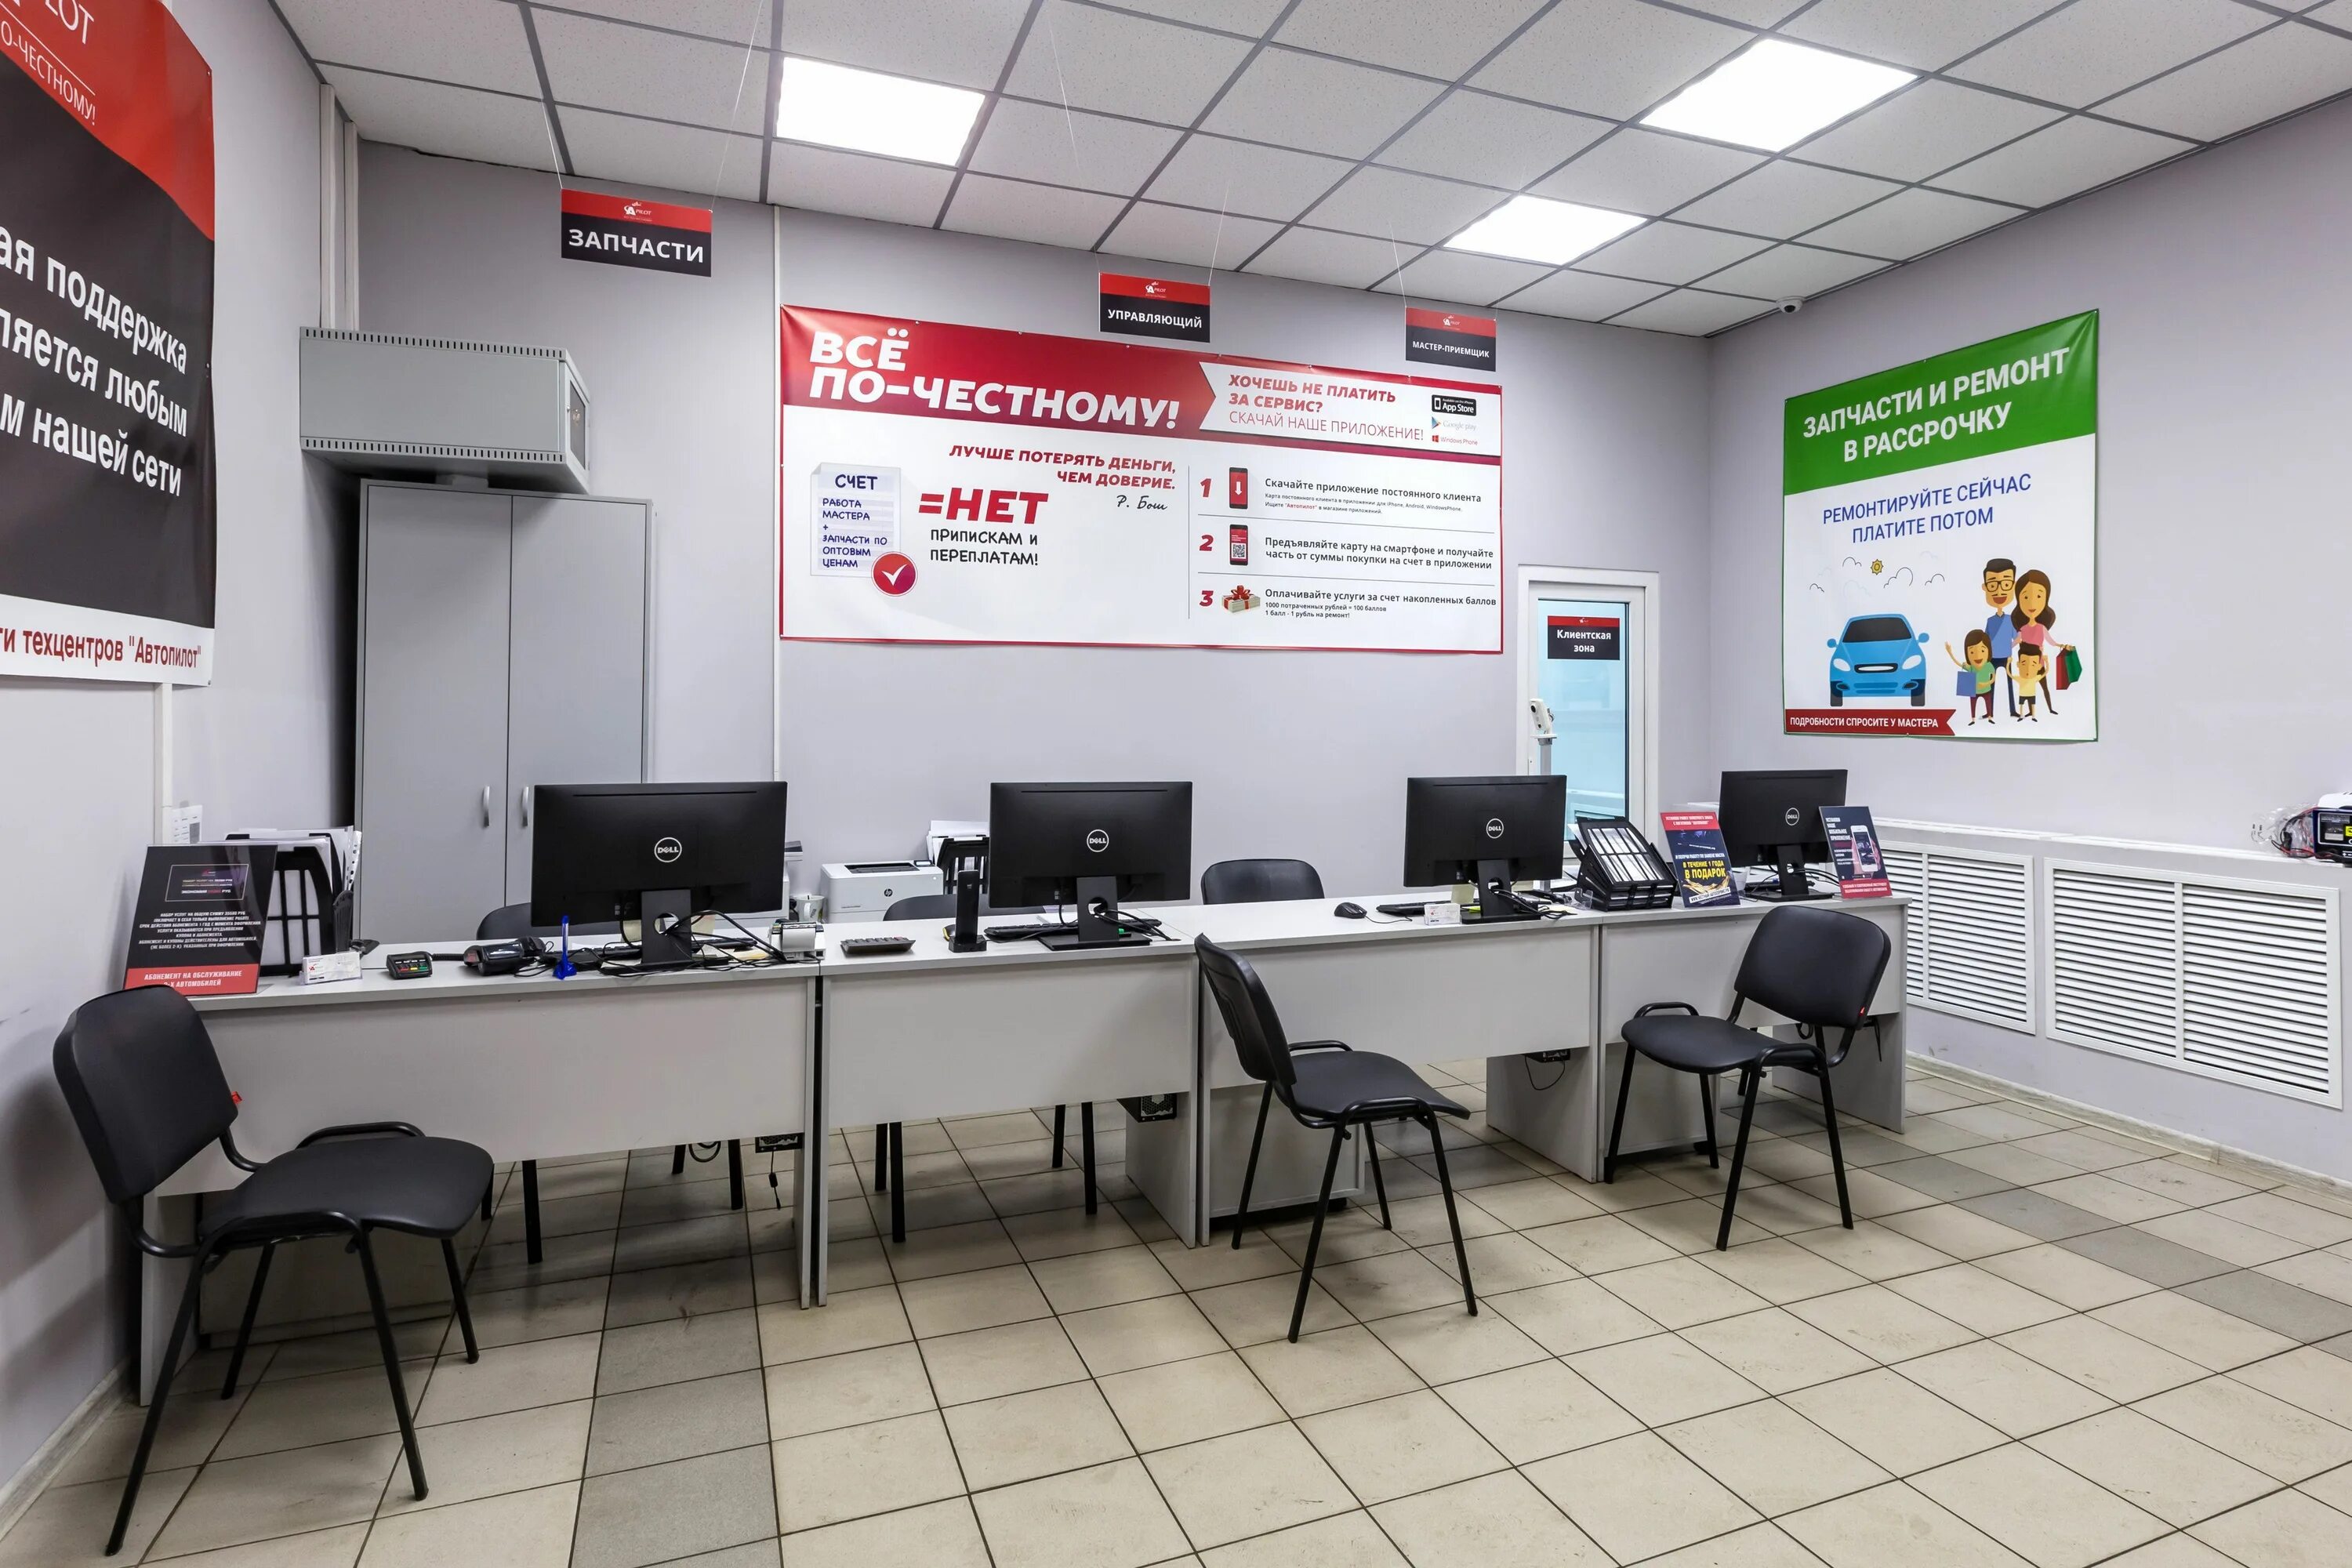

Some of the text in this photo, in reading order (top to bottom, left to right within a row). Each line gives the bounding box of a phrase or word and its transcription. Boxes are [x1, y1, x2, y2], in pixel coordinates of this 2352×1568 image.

[568, 229, 703, 263] ЗАПЧАСТИ
[47, 256, 187, 375] поддержка
[1108, 309, 1202, 328] УПРАВЛЯЮЩИЙ
[809, 327, 909, 372] ВСЁ
[1413, 341, 1490, 358] МАСТЕР-ПРИЕМЩИК
[1229, 375, 1396, 402] ХОЧЕШЬ НЕ ПЛАТИТЬ
[1803, 347, 2070, 438] ЗАПЧАСТИ И РЕМОНТ
[105, 368, 187, 437] любым
[809, 367, 1180, 429] ПО-ЧЕСТНОМУ!
[1229, 393, 1323, 412] ЗА СЕРВИС?
[1443, 402, 1474, 413] App Store
[1229, 412, 1424, 441] СКАЧАЙ НАШЕ ПРИЛОЖЕНИЕ!
[1443, 420, 1464, 430] Google
[1844, 401, 2013, 463] В РАССРОЧКУ
[32, 408, 128, 475] нашей
[132, 450, 181, 496] сети
[949, 445, 1176, 474] ЛУЧШЕ ПОТЕРЯТЬ ДЕНЬГИ,
[835, 474, 878, 490] СЧЕТ
[1057, 471, 1175, 489] ЧЕМ ДОВЕРИЕ.
[1200, 478, 1212, 498] 1
[1265, 478, 1481, 503] Скачайте приложение постоянного клиента
[1823, 473, 2031, 524] РЕМОНТИРУЙТЕ СЕЙЧАС
[822, 498, 861, 508] РАБОТА
[1116, 495, 1167, 510] Р. Бош
[822, 510, 870, 521] МАСТЕРА
[1853, 506, 1993, 544] ПЛАТИТЕ ПОТОМ
[822, 535, 869, 544] ЗАПЧАСТИ
[931, 529, 1038, 545] ПРИПИСКАМ И
[1199, 534, 1214, 552] 2
[822, 546, 871, 557] ОПТОВЫМ
[1265, 537, 1338, 549] Предъявляйте
[1341, 543, 1367, 553] карту
[1384, 545, 1435, 555] смартфоне
[1446, 549, 1494, 558] получайте
[822, 558, 858, 568] ЦЕНАМ
[931, 549, 1038, 566] ПЕРЕПЛАТАМ!
[1310, 554, 1344, 563] суммы
[1347, 555, 1387, 564] покупки
[1434, 560, 1492, 569] приложении
[1199, 590, 1214, 607] 3
[1265, 589, 1331, 599] Оплачивайте
[1334, 593, 1365, 602] услуги
[1403, 595, 1464, 604] накопленных
[1465, 597, 1497, 605] баллов
[1296, 611, 1314, 619] рубль
[1557, 630, 1611, 640] Клиентская
[23, 630, 123, 667] техцентров
[129, 636, 201, 668] "Автопилот"
[1790, 717, 1938, 728] ПОДРОБНОСТИ СПРОСИТЕ У МАСТЕРА
[1685, 868, 1726, 880] В ПОДАРОК
